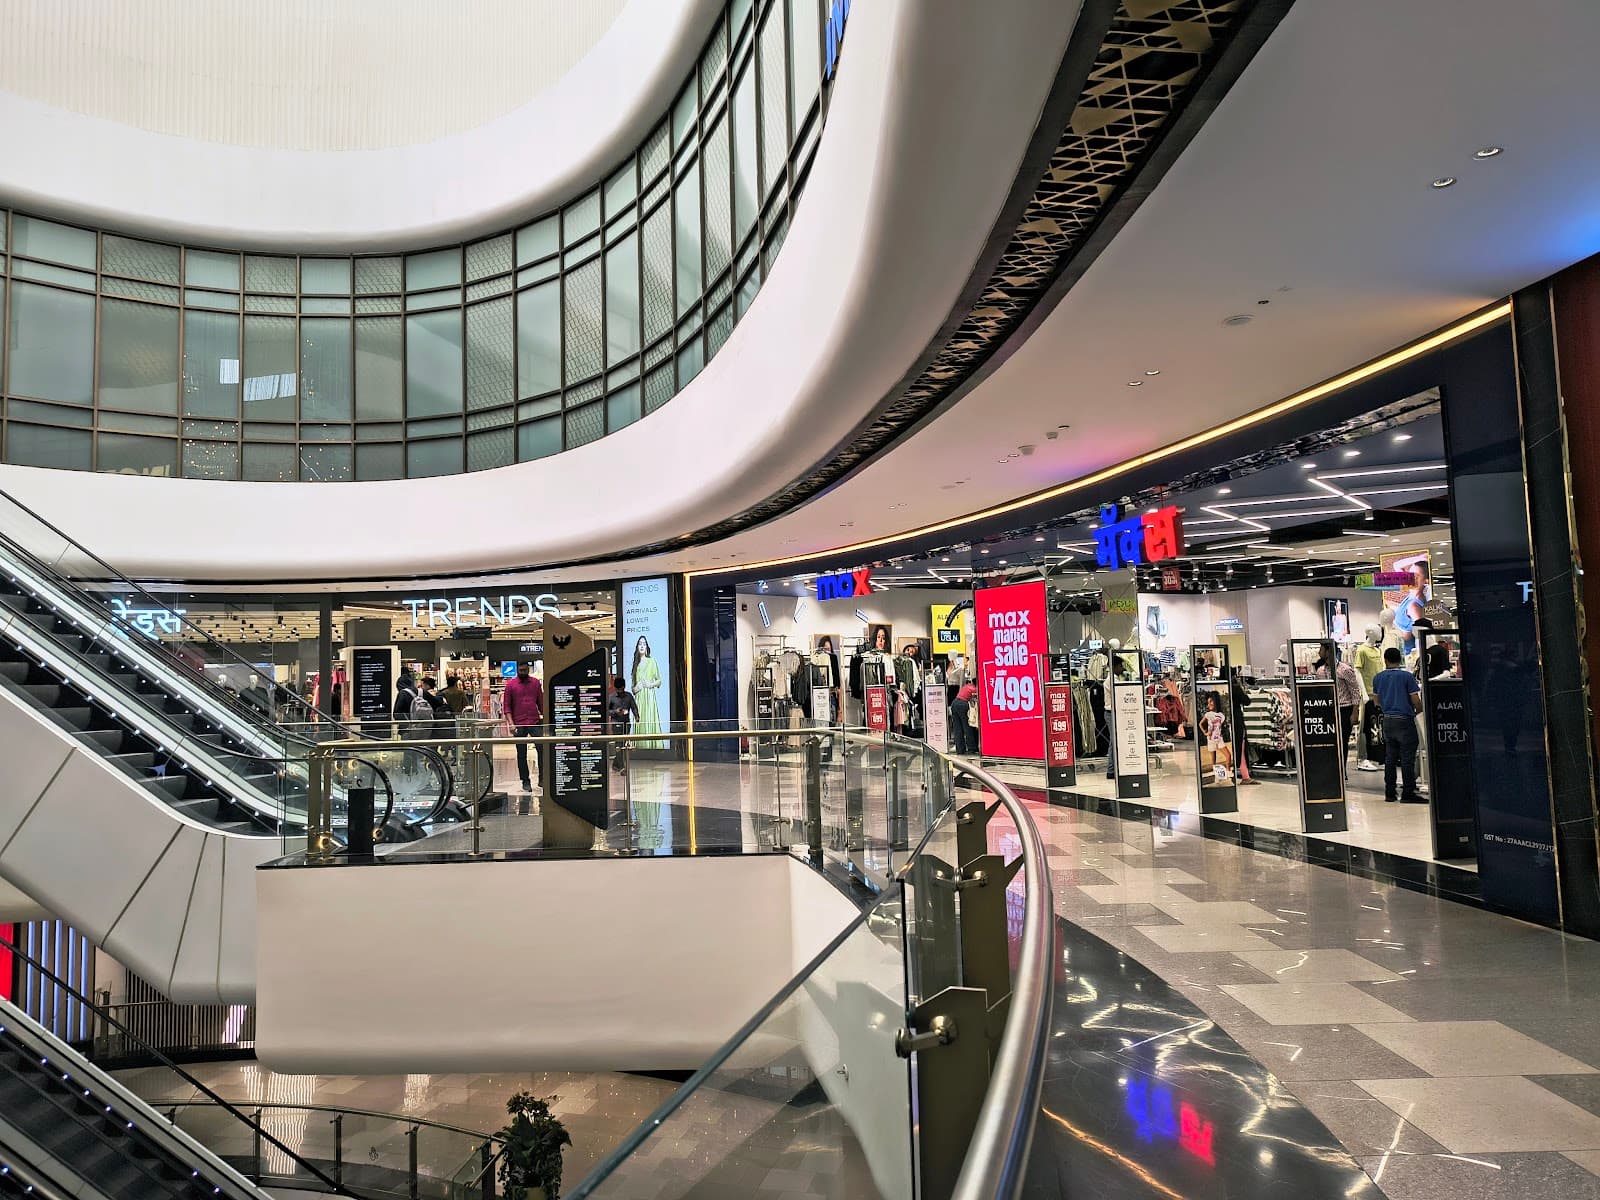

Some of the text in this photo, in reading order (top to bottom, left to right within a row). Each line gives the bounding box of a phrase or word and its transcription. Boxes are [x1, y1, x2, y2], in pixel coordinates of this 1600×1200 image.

[631, 584, 659, 594] TRENDS
[816, 568, 871, 601] max
[402, 593, 561, 629] TRENDS
[988, 610, 1031, 629] max
[993, 626, 1028, 645] mania
[995, 641, 1029, 667] sale
[1437, 702, 1463, 710] ALAYA
[1483, 833, 1495, 841] GST
[1495, 835, 1504, 843] No
